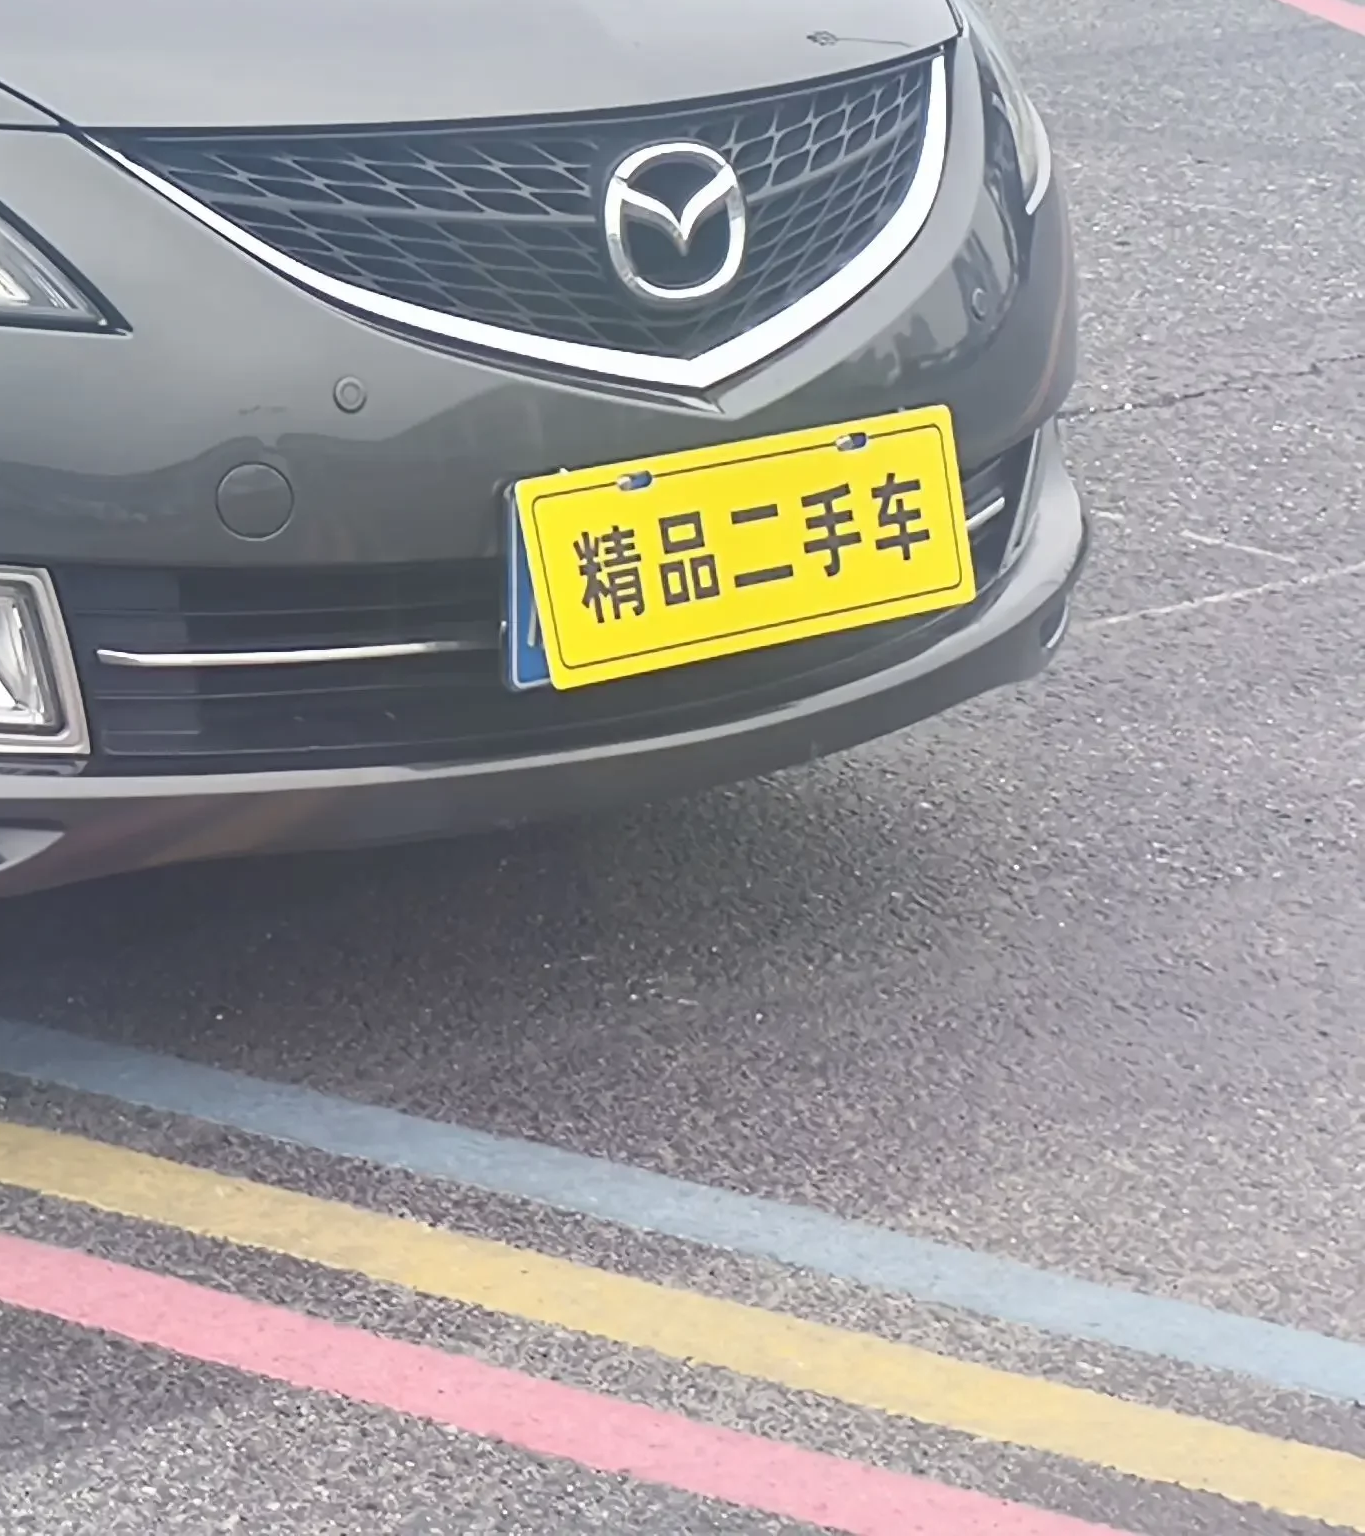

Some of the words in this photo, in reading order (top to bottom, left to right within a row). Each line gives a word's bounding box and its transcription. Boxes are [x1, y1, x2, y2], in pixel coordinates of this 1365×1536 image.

[572, 471, 931, 624] 精品二手车
